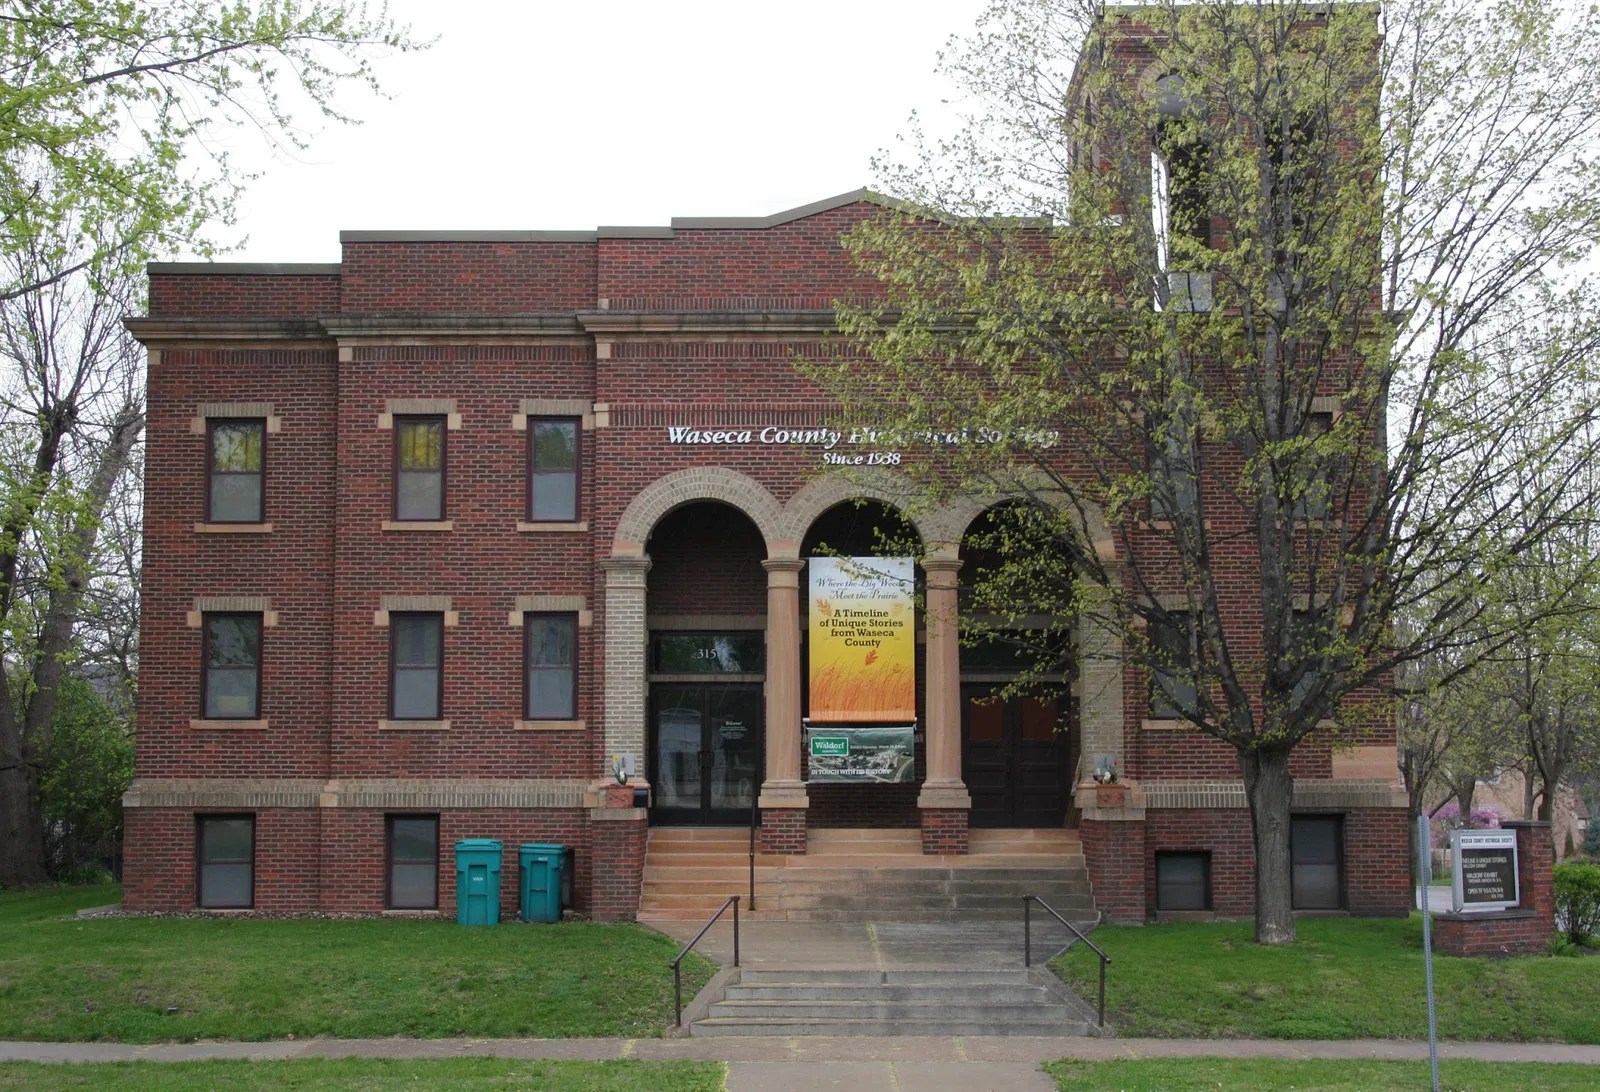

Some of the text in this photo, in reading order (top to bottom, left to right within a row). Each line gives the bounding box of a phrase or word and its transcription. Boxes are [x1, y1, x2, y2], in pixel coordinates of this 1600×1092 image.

[668, 427, 751, 444] Waseca
[760, 427, 841, 449] County
[823, 452, 901, 465] Since 1938
[816, 577, 844, 588] Where
[845, 579, 858, 588] the
[830, 588, 899, 599] Meet the Prairie
[834, 609, 889, 617] A Timeline
[819, 619, 904, 629] of Unique Stories
[831, 629, 895, 637] from Waseca
[845, 638, 881, 648] County
[697, 649, 717, 659] 315
[815, 742, 844, 750] Waldorf
